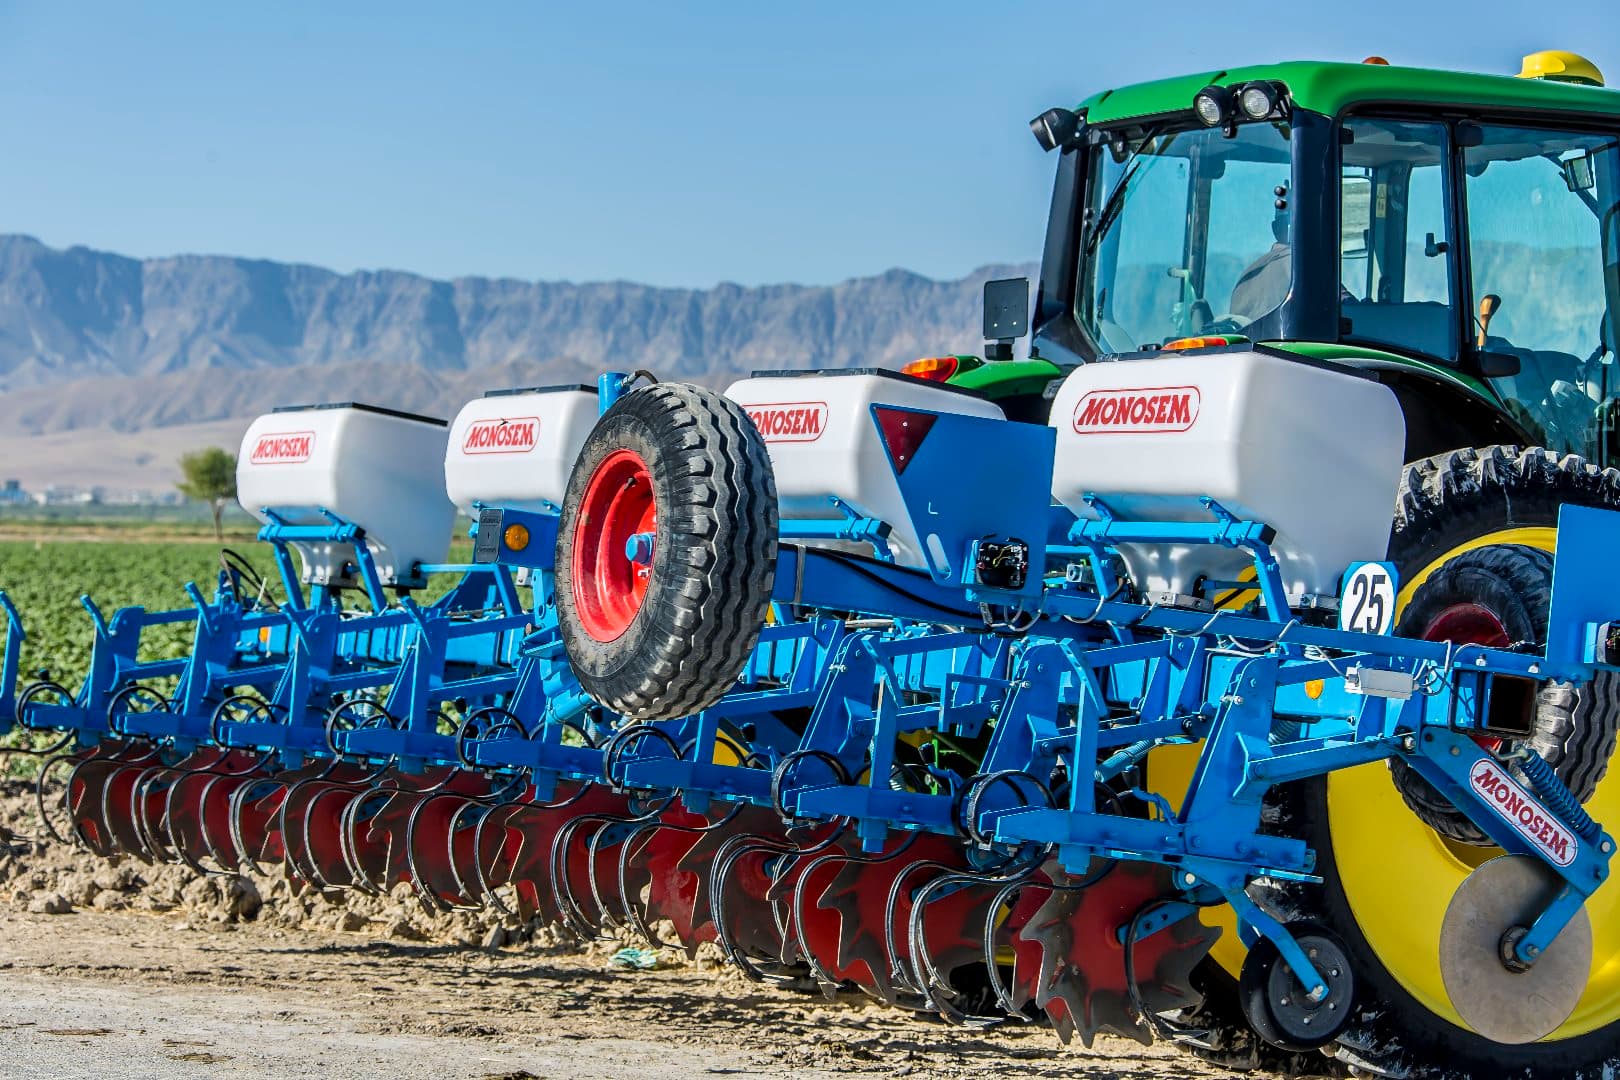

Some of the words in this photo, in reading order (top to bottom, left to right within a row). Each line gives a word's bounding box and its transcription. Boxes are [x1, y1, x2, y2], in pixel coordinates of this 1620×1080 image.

[748, 408, 820, 435] ONOSEM
[1077, 394, 1191, 425] MONOSEM
[253, 437, 310, 458] MONOSEM
[466, 423, 534, 448] MONOSEM
[1349, 573, 1386, 635] 25
[1475, 768, 1569, 861] MONOSEM
